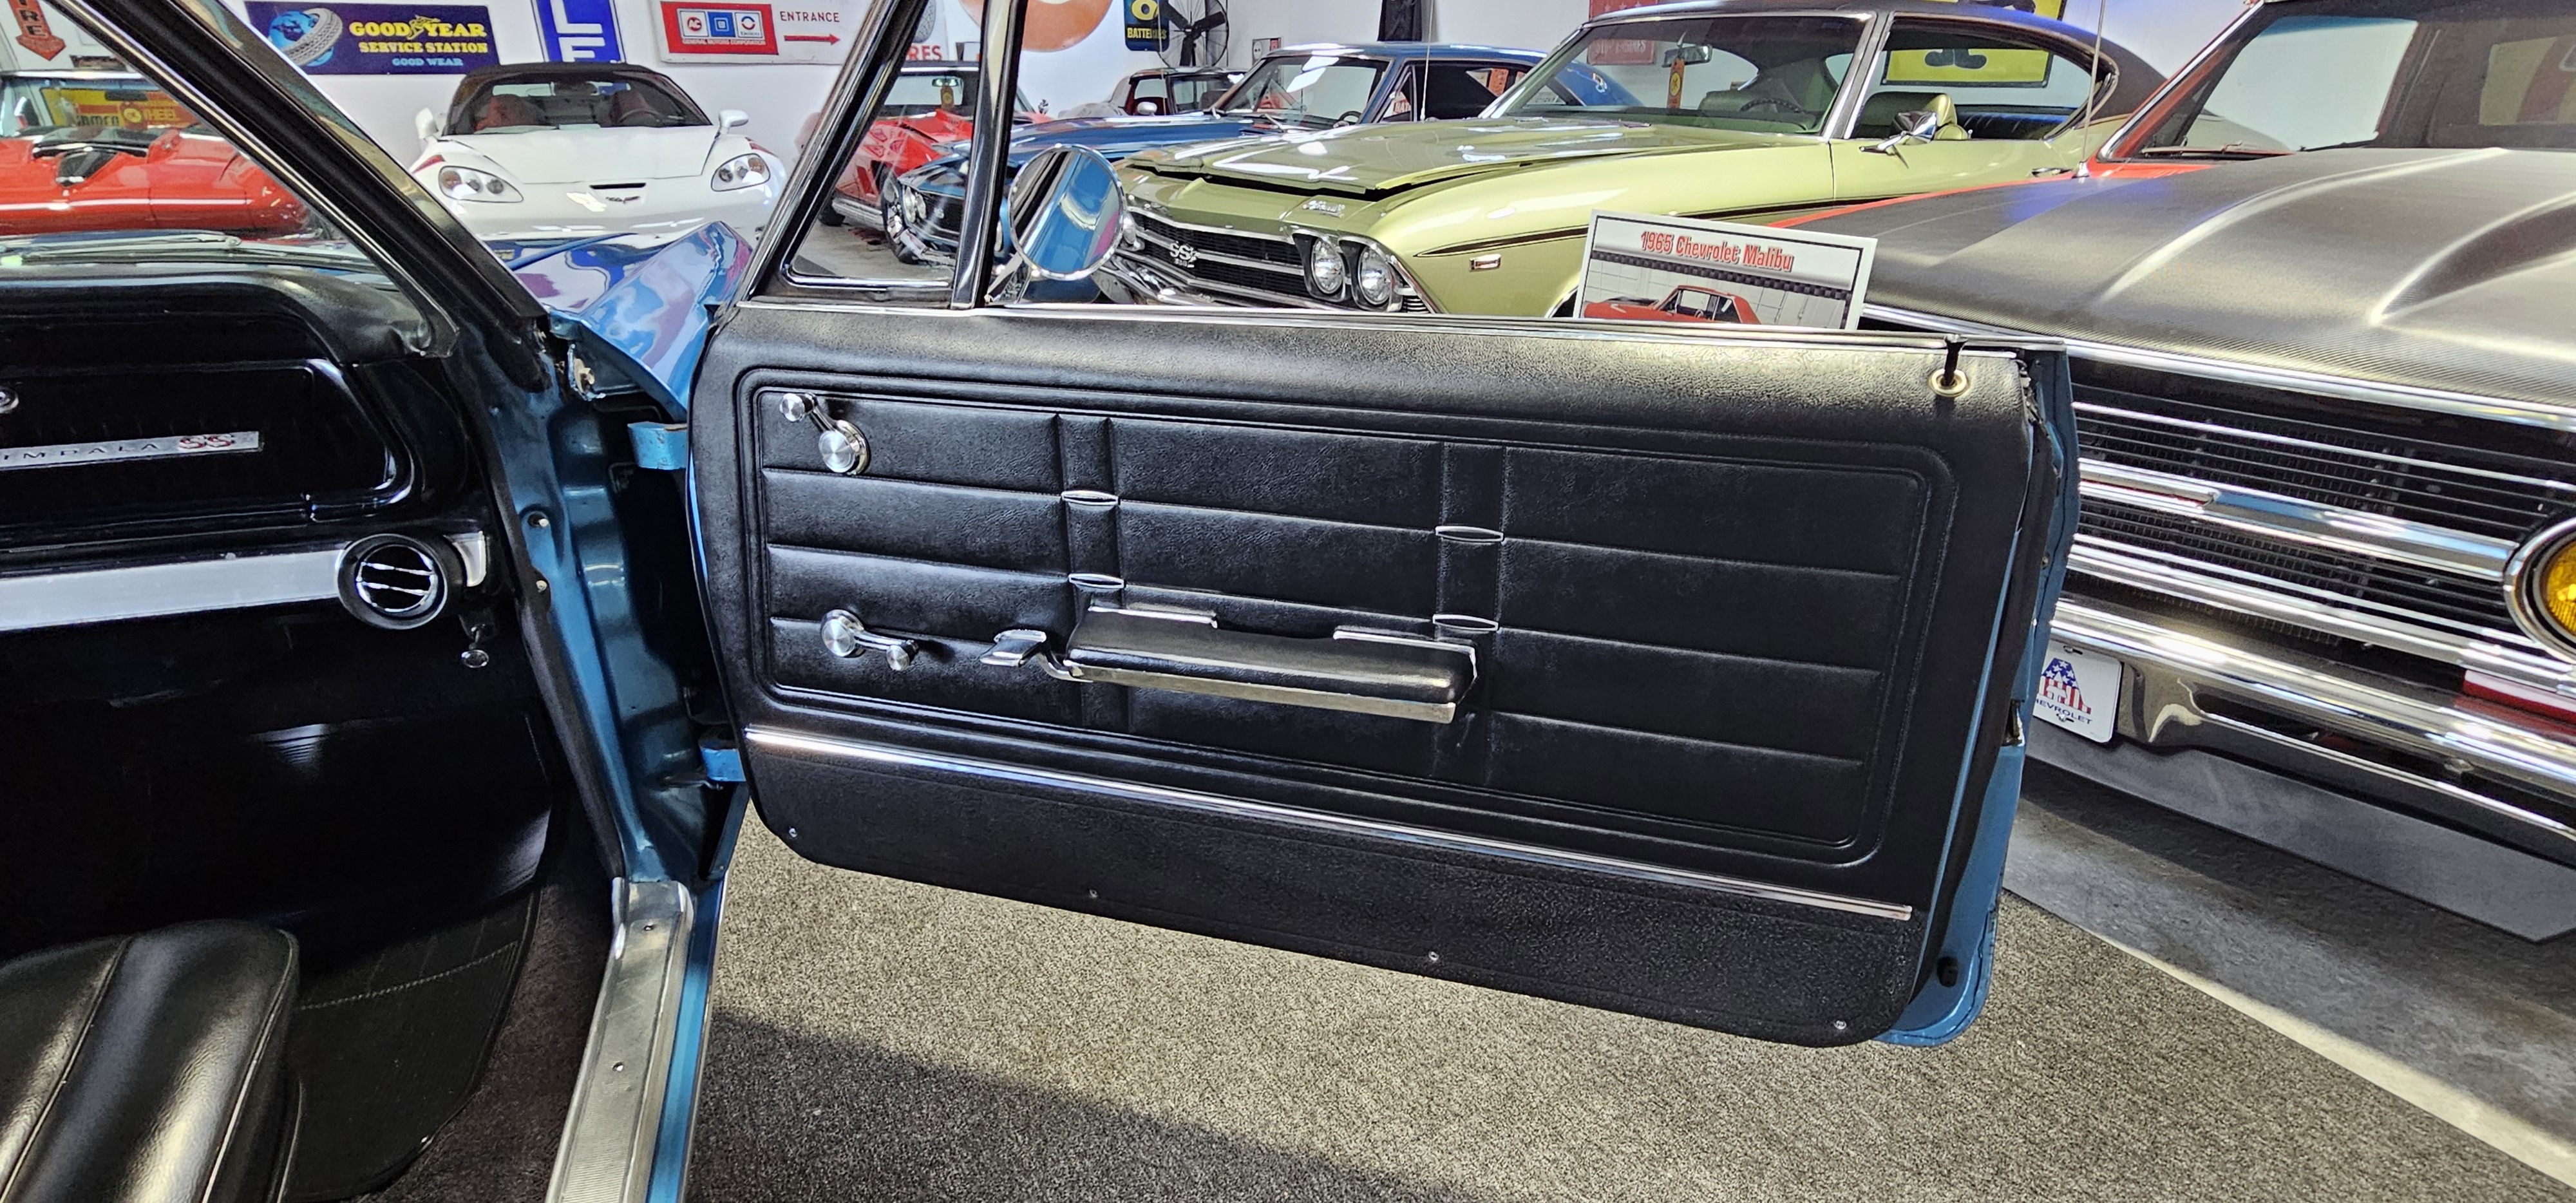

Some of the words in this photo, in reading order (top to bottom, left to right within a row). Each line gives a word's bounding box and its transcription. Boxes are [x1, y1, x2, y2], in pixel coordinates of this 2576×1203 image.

[779, 11, 840, 23] ENTRANCE
[358, 42, 423, 53] SERVICE
[425, 43, 488, 53] STATION
[392, 58, 424, 66] GOOD
[426, 58, 464, 66] WEAR
[1641, 231, 1674, 254] 1965
[1676, 236, 1741, 265] Chevrolet
[1743, 243, 1795, 272] Malibu
[178, 434, 234, 450] SS
